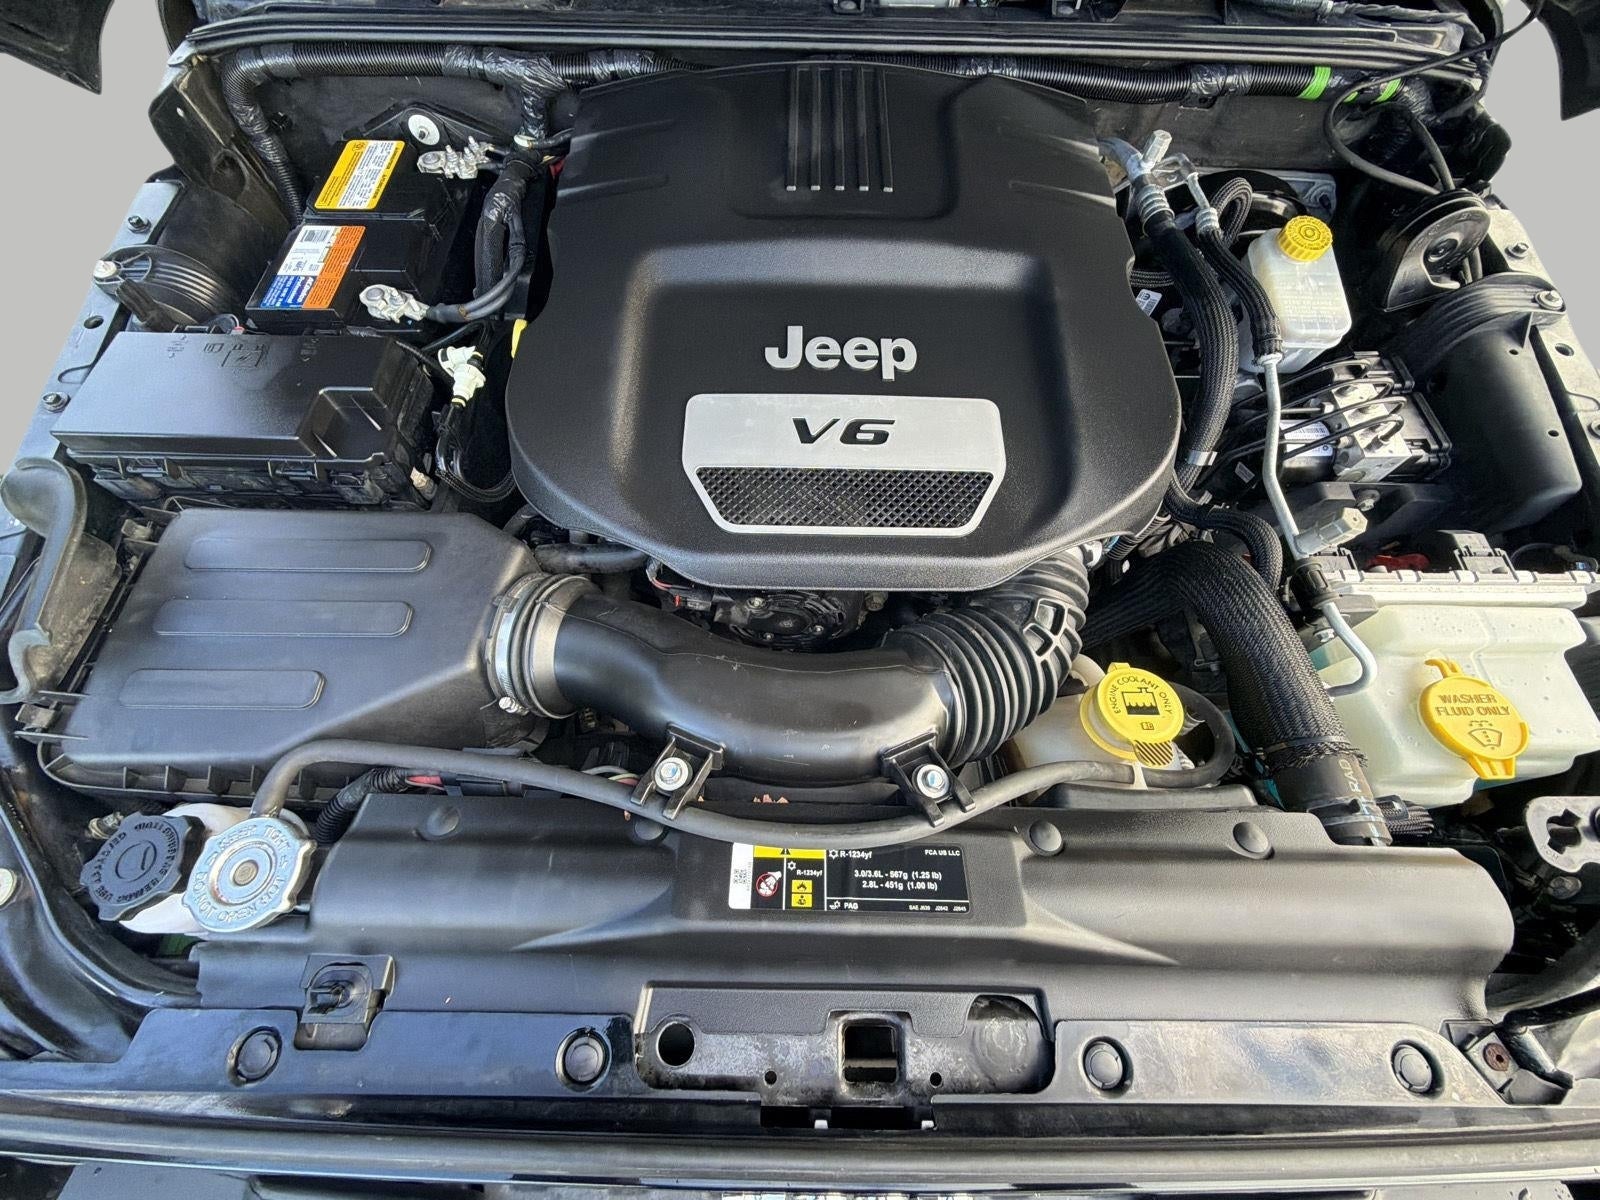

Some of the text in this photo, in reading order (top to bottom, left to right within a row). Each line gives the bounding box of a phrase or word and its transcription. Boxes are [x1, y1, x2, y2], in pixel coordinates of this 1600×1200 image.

[764, 325, 918, 382] Jeep
[792, 417, 896, 445] V6
[1109, 675, 1173, 715] ENGINE COOLANT ONLY
[1438, 693, 1498, 704] WASHER
[1435, 706, 1511, 717] FLUID ONLY
[1338, 758, 1363, 793] RAD
[264, 824, 291, 850] TIGHT
[840, 850, 873, 860] R-1234yf
[796, 869, 823, 877] R-1234yf
[854, 870, 883, 878] 3.0/3.6L
[889, 871, 908, 880] 567g
[911, 871, 930, 880] (1.25
[931, 871, 942, 881] lb)
[884, 881, 904, 890] 451g
[907, 881, 926, 891] (1.00
[927, 882, 938, 891] lb)
[194, 893, 218, 919] NOT
[217, 902, 258, 923] OPEN
[843, 902, 859, 910] PAG
